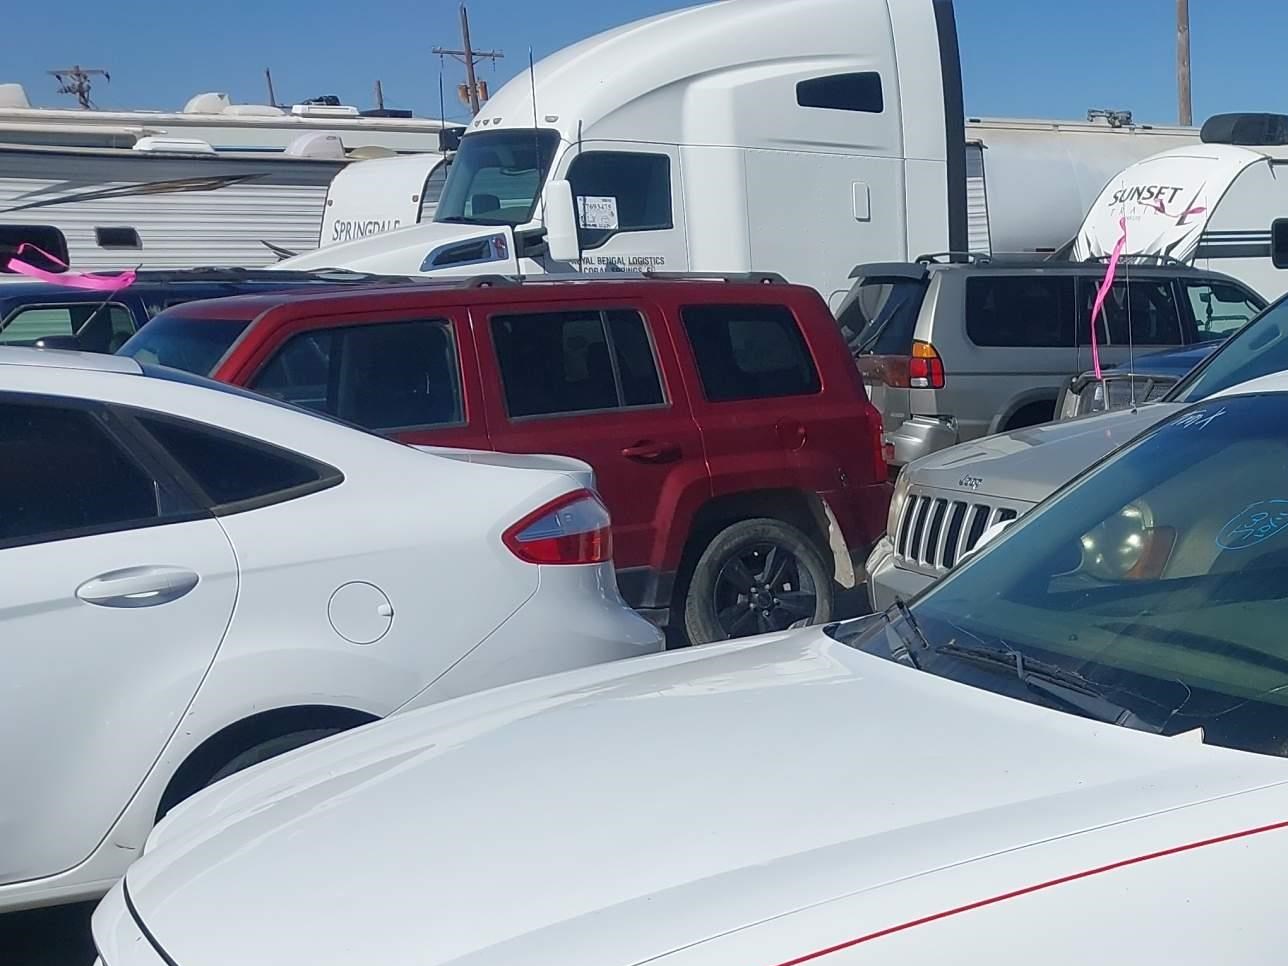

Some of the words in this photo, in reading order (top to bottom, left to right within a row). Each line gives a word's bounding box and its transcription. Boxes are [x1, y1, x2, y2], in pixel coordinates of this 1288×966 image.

[1108, 185, 1184, 206] SUNSET
[597, 256, 625, 265] BENGAL
[628, 256, 665, 265] LOGISTICS
